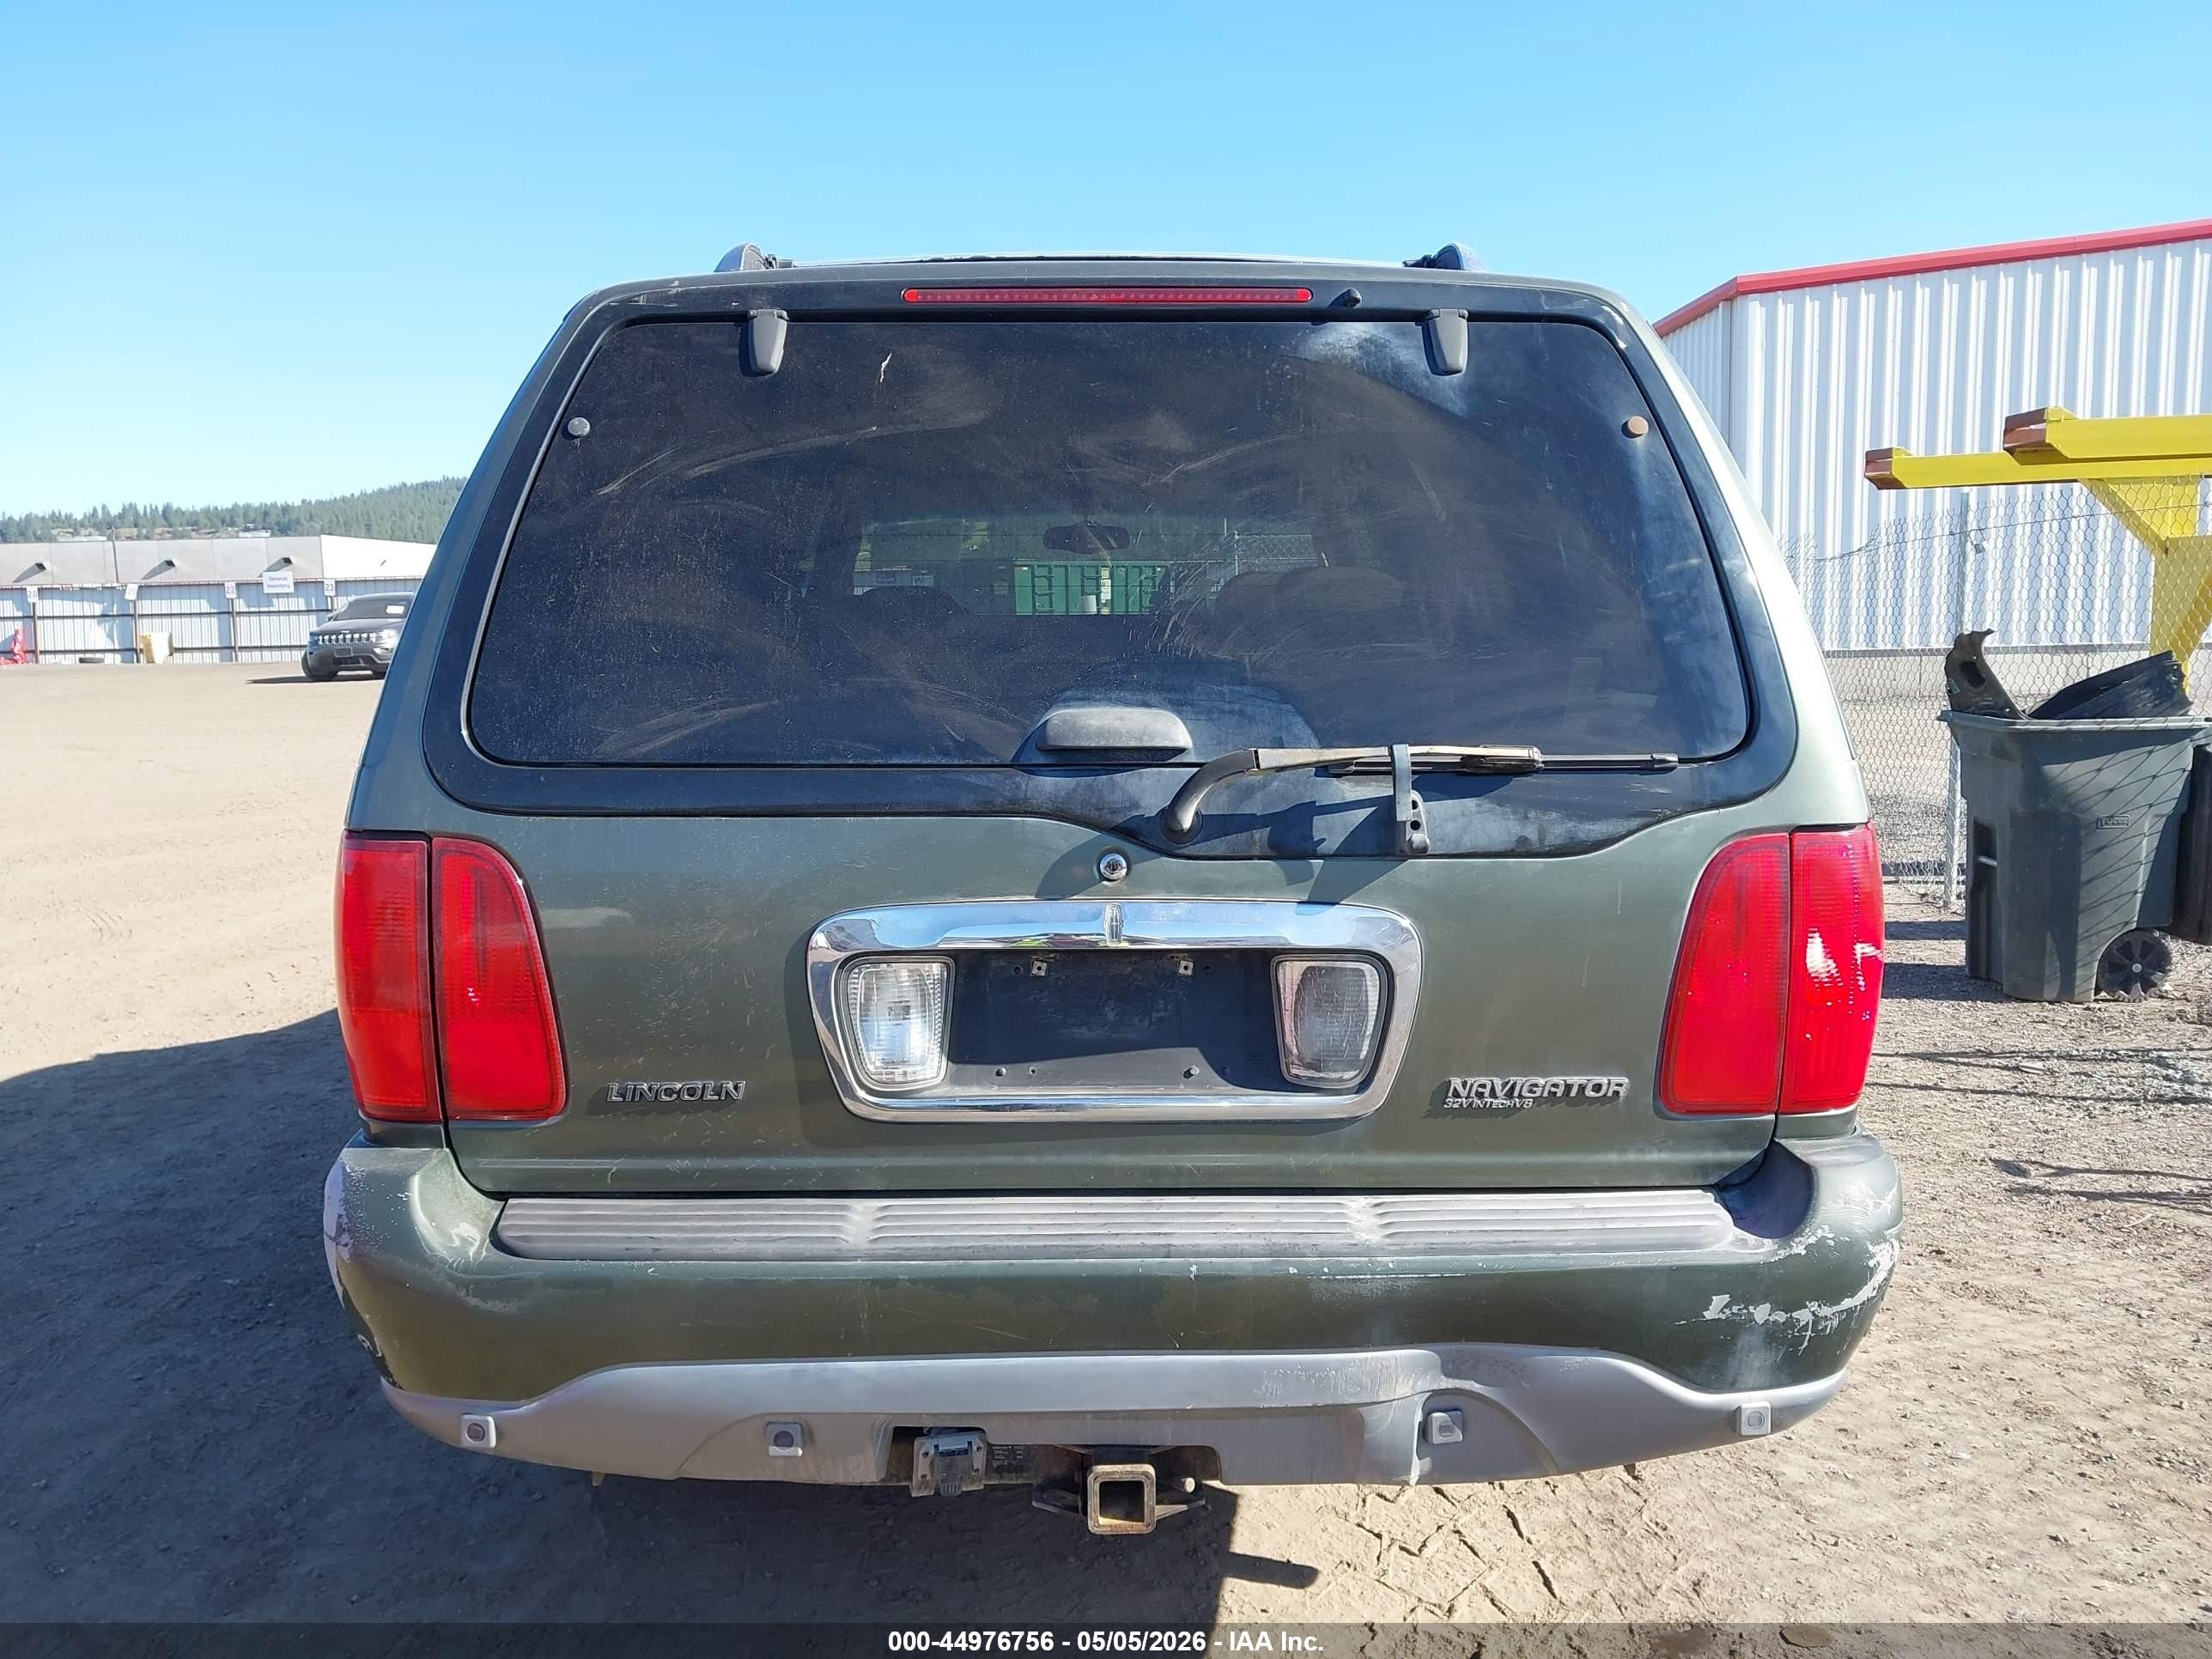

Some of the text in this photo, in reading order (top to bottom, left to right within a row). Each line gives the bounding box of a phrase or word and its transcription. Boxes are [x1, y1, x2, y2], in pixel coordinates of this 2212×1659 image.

[226, 586, 236, 595] 22
[325, 583, 335, 592] 23
[27, 590, 38, 599] 20
[606, 1080, 746, 1102] LINCOLN
[1447, 1077, 1630, 1098] NAVIGATOR
